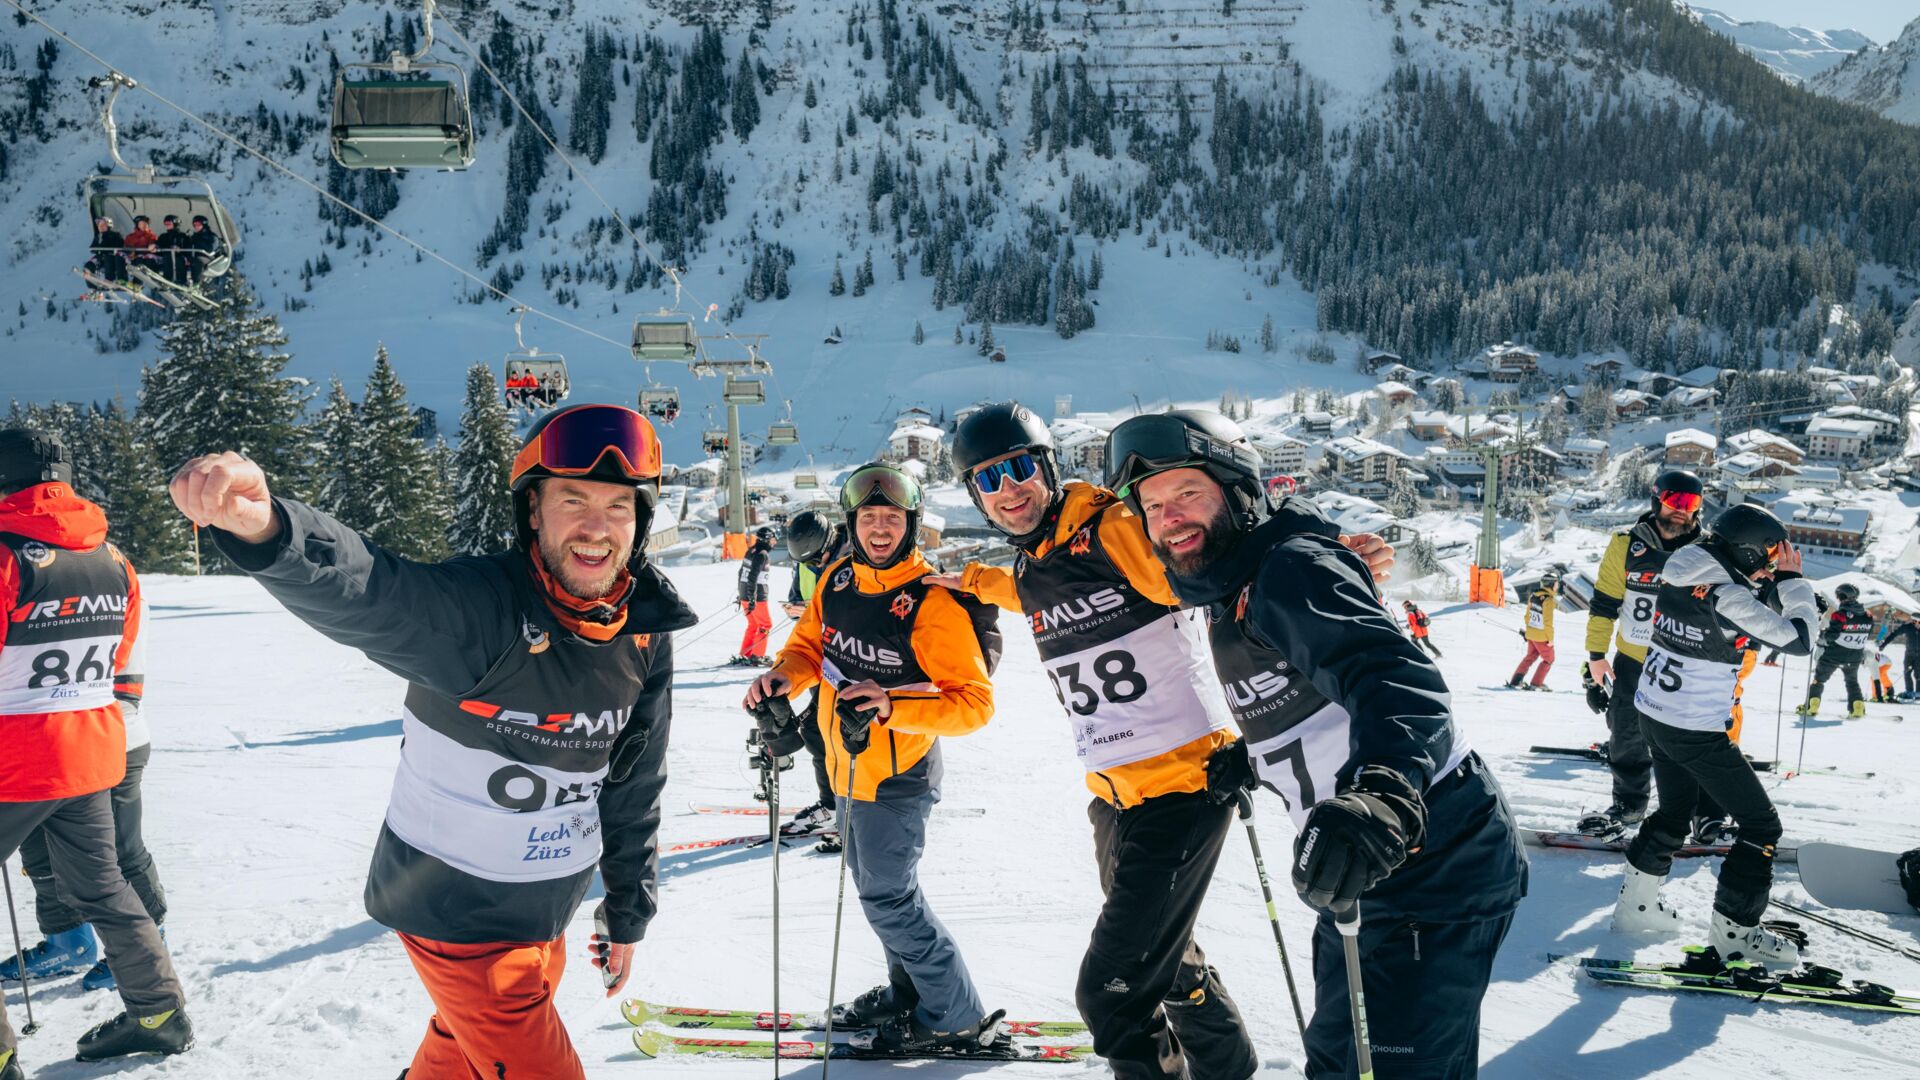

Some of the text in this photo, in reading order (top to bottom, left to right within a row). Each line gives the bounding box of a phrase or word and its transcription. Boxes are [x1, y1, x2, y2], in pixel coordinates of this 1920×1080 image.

[1211, 445, 1233, 459] SMITH
[1027, 587, 1125, 634] EMUS
[28, 616, 89, 629] PERFORMANCE
[1057, 626, 1077, 639] SPORT
[1079, 607, 1131, 630] EXHAUSTS
[840, 654, 857, 665] SPORT
[51, 687, 79, 698] Zürs
[1245, 689, 1299, 719] EXHAUSTS
[487, 722, 580, 749] PERFORMANCE
[1092, 730, 1134, 745] ARLBERG
[528, 823, 570, 843] Lech
[670, 836, 765, 850] ATOMIC
[1299, 826, 1321, 872] reusch
[523, 844, 571, 861] Zürs
[1377, 1046, 1414, 1054] HOUDINI
